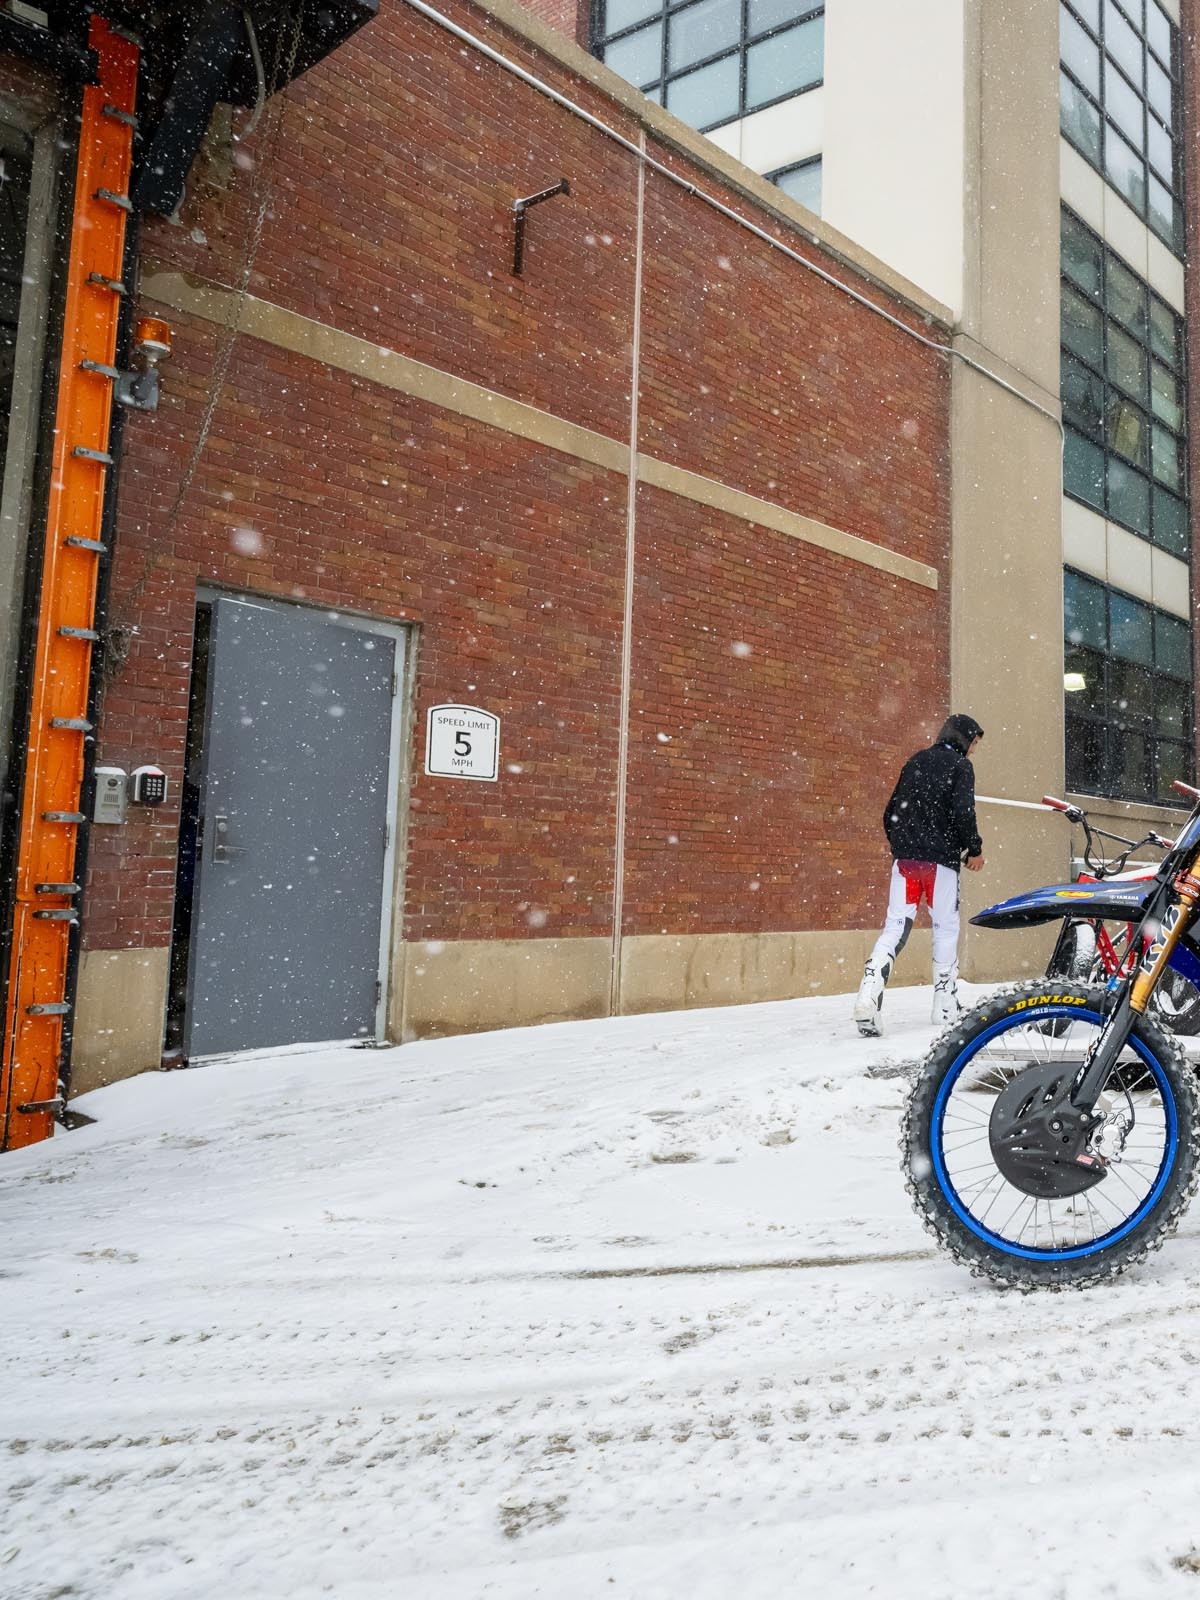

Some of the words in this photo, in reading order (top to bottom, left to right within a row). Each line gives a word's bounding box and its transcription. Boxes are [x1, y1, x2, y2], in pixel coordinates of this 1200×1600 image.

[437, 716, 465, 727] SPEED
[467, 721, 491, 730] LIMIT
[454, 731, 472, 756] 5
[451, 758, 473, 768] MPH
[1015, 995, 1087, 1011] DUNLOP
